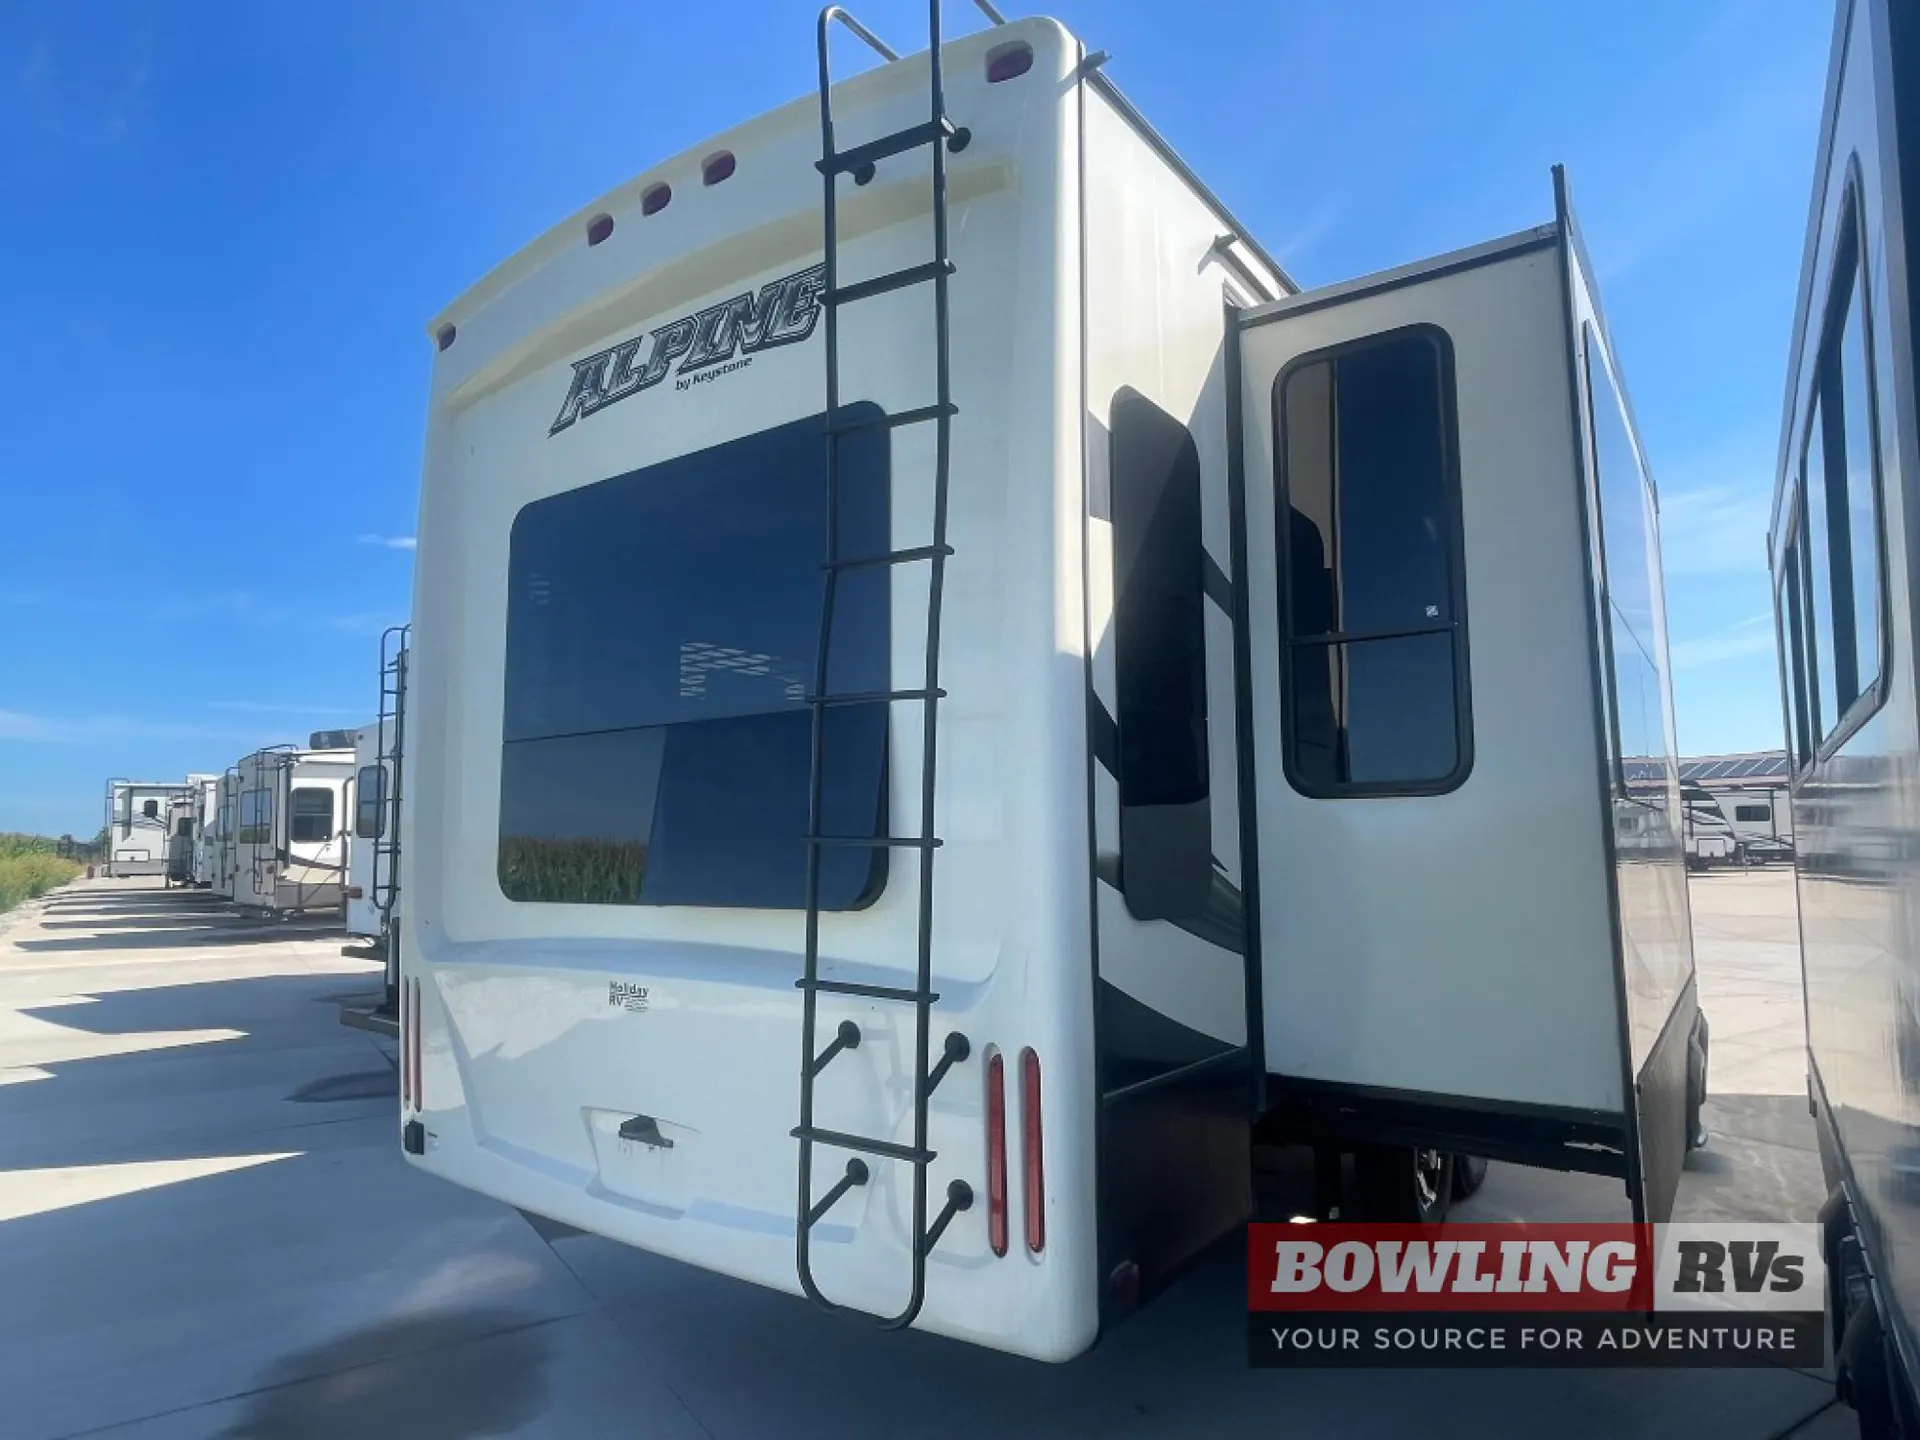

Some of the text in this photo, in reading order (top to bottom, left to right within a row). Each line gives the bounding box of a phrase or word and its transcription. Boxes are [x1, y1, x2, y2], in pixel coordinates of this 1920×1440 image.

[547, 261, 826, 438] ALPINE
[676, 358, 752, 390] by Keystone
[609, 995, 623, 1006] RV
